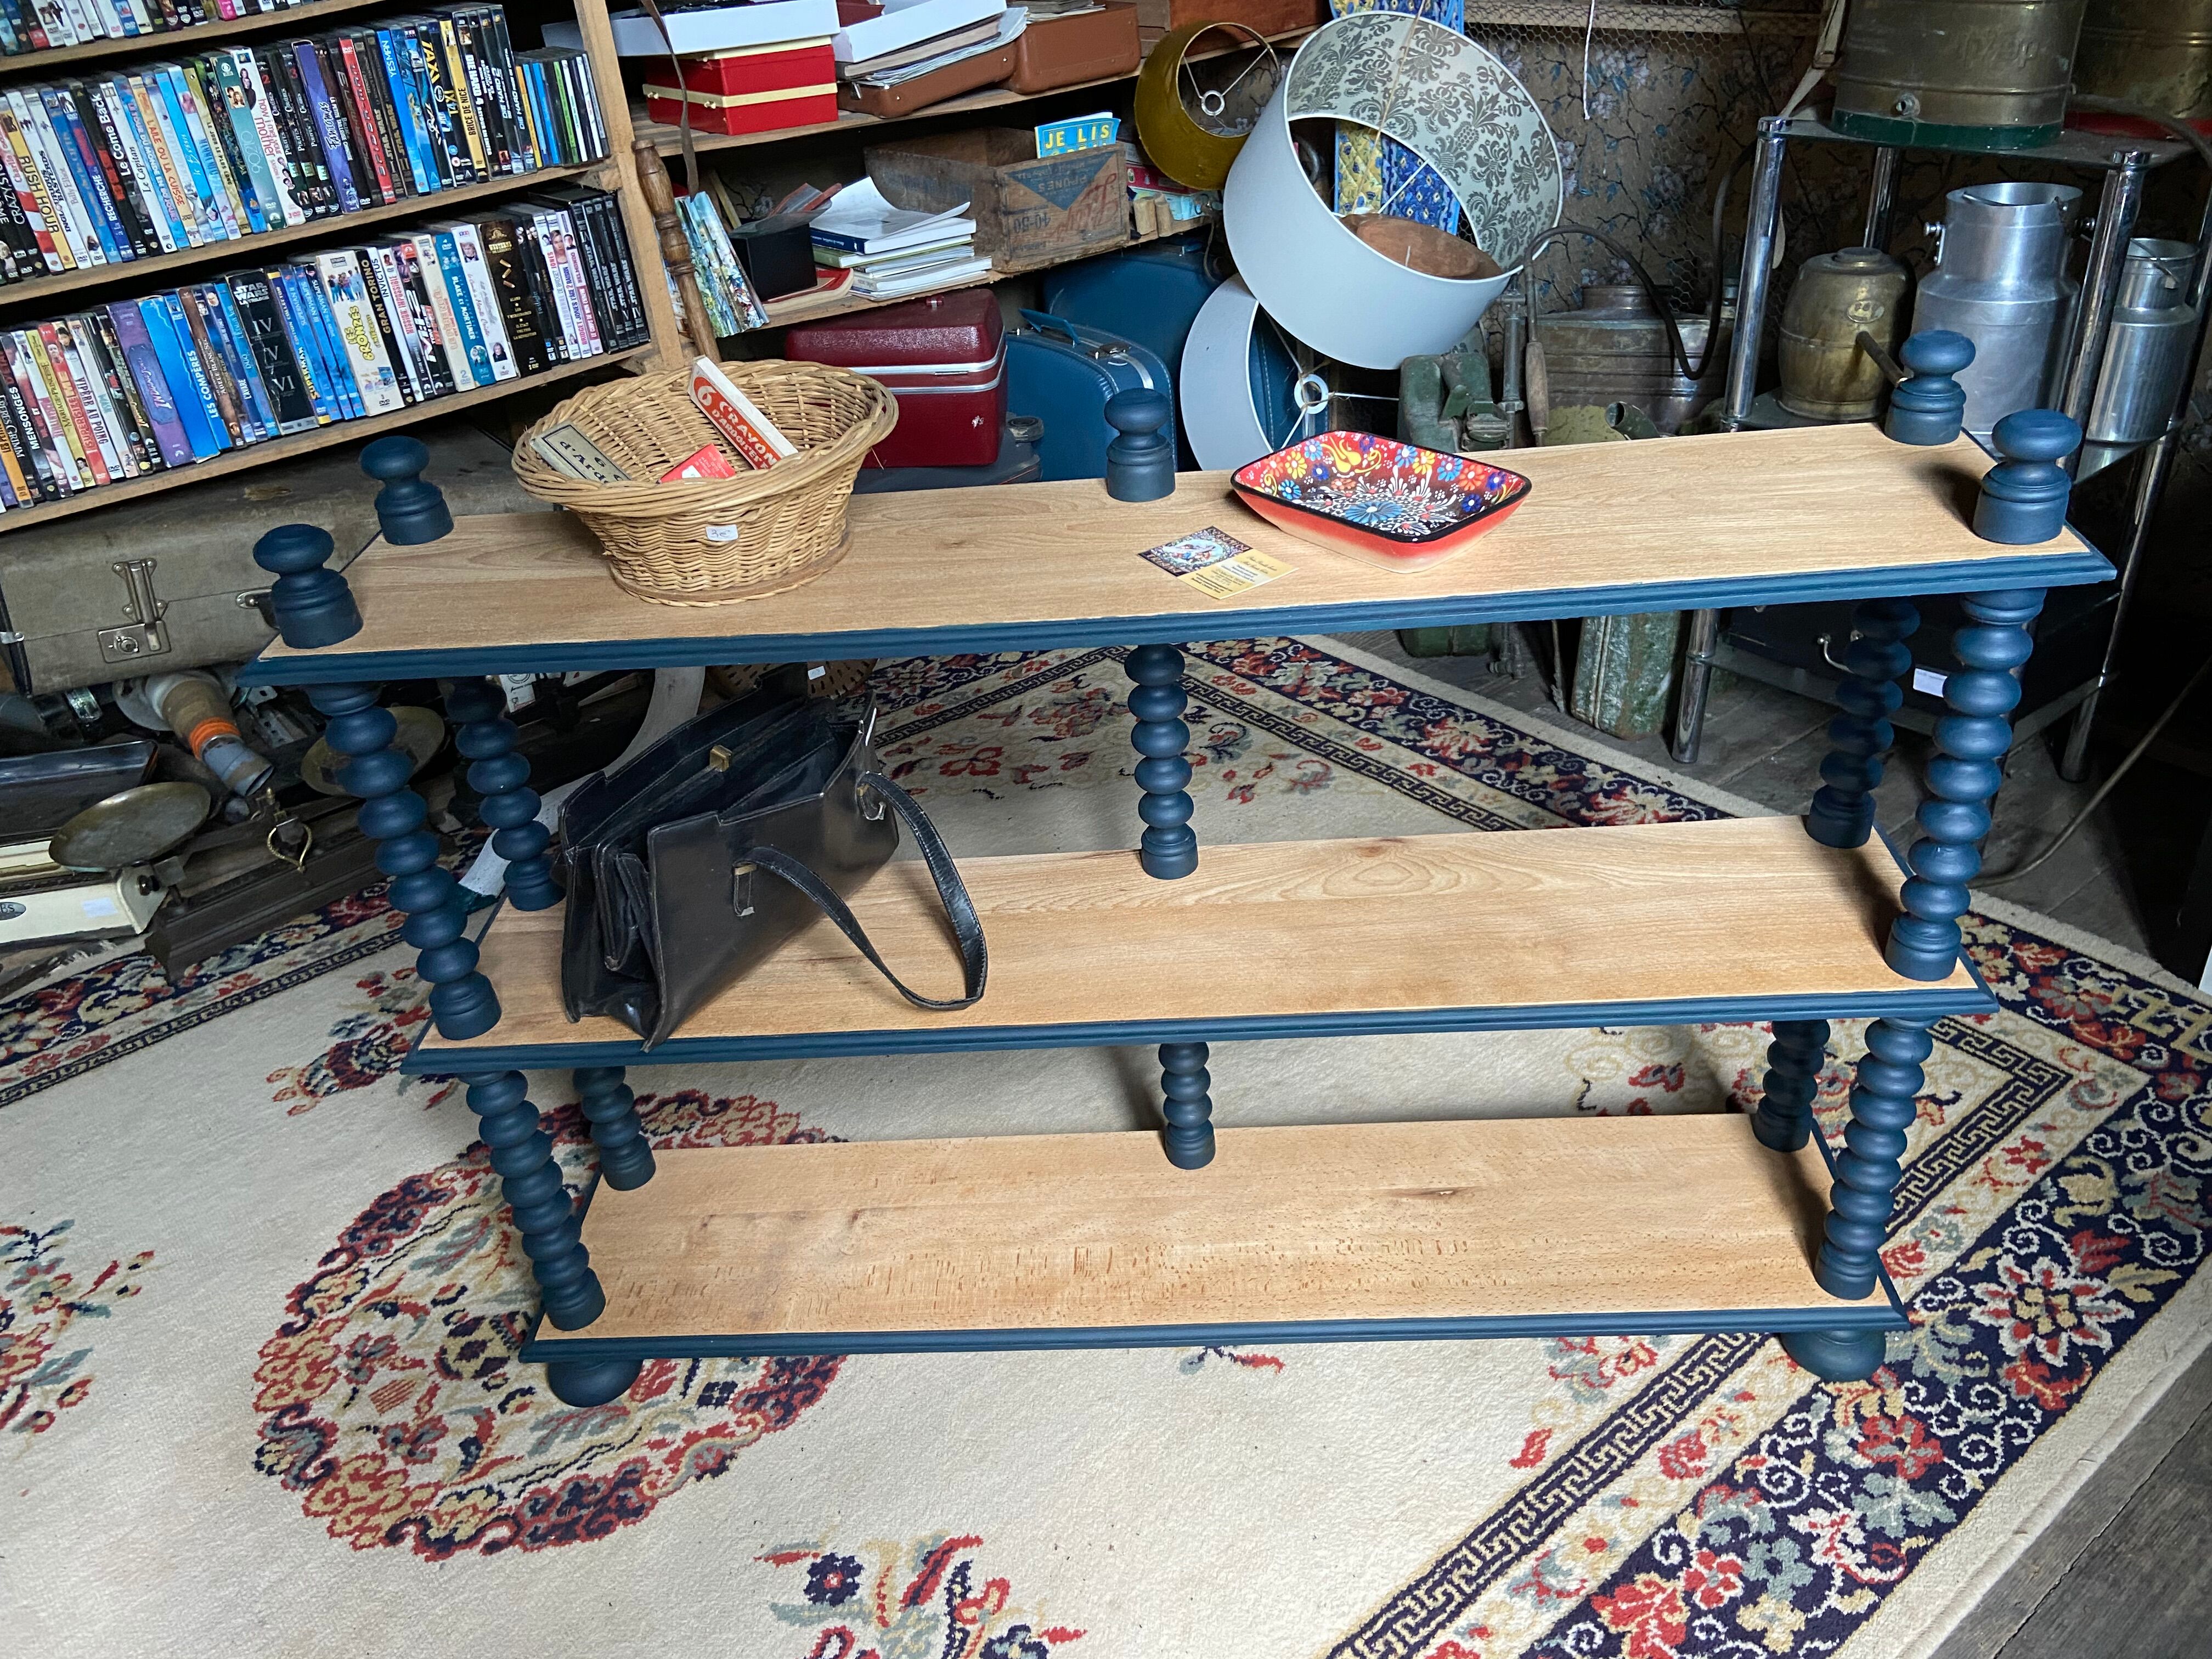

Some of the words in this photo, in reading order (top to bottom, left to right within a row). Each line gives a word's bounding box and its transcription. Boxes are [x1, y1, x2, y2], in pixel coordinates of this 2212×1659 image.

[421, 40, 441, 83] TAXI
[465, 54, 475, 70] DIE
[491, 66, 500, 77] 2
[458, 87, 467, 105] NICE
[467, 70, 482, 96] HARD
[494, 77, 505, 104] HARD
[92, 92, 111, 124] Back
[257, 99, 269, 118] how
[464, 105, 471, 116] DE
[475, 97, 484, 105] 4
[500, 104, 508, 119] DIE
[512, 90, 522, 115] HARD
[350, 64, 387, 177] SPIDER-MAN
[374, 108, 385, 135] WARS
[386, 103, 398, 131] WARS
[467, 116, 477, 137] BRICE
[517, 115, 525, 130] DIE
[105, 125, 125, 160] Come
[146, 119, 162, 145] L'AILE
[254, 117, 276, 156] mother
[267, 124, 278, 139] met
[393, 129, 405, 156] STAR
[1045, 131, 1065, 150] JE
[1077, 124, 1110, 143] LIS
[139, 135, 149, 149] DU
[144, 147, 161, 177] MONDE
[157, 147, 170, 161] OU
[208, 130, 218, 145] JOUR
[213, 146, 221, 154] LE
[217, 155, 227, 170] PLUS
[223, 170, 233, 186] LONG
[240, 131, 261, 174] 90210
[272, 138, 282, 155] your
[382, 133, 393, 160] STAR
[39, 150, 64, 201] BASTERDS
[120, 161, 131, 176] Le
[129, 146, 146, 180] Capitan
[163, 162, 174, 174] LA
[19, 156, 43, 192] RUSH
[35, 196, 59, 234] HOUR
[92, 174, 118, 222] RECHERCHE
[141, 179, 152, 193] Le
[168, 176, 185, 206] CUISSE
[42, 170, 72, 233] INGLOURIOUS
[547, 251, 557, 269] JONES
[570, 252, 583, 283] BELMONDO
[585, 244, 595, 268] STAR
[590, 268, 602, 291] WARS
[621, 259, 632, 283] WARS
[360, 258, 378, 301] TORINO
[371, 258, 390, 297] INVICTUS
[602, 264, 612, 289] WARS
[610, 262, 621, 286] WARS
[234, 282, 268, 295] STAR
[234, 289, 268, 301] WARS
[312, 279, 328, 314] SUPERMAN
[390, 275, 407, 310] IMPOSSIBLE
[608, 287, 618, 312] STAR
[617, 286, 627, 309] STAR
[628, 282, 638, 305] STAR
[376, 305, 391, 335] GRAN
[451, 275, 464, 297] BLAKE
[460, 305, 476, 340] MORTIMER
[573, 302, 582, 322] JONES
[343, 327, 358, 345] LES
[348, 305, 374, 361] BRONZÉS
[576, 321, 588, 346] BRIDGET
[57, 371, 77, 398] ME
[187, 349, 213, 402] COMPÈRES
[271, 375, 296, 392] VI
[298, 346, 321, 400] SUPERMAN
[460, 369, 467, 379] 2
[238, 379, 252, 399] L'AVARE
[697, 385, 717, 407] 6
[9, 386, 41, 450] MENSONGES
[57, 398, 72, 427] MARIAGE
[66, 397, 83, 419] SIZE
[75, 376, 94, 406] VIPÈRE
[87, 408, 97, 423] AU
[93, 424, 109, 445] POING
[206, 404, 219, 419] LES
[6, 424, 25, 459] GRIMM
[75, 416, 95, 452] SUPER
[712, 409, 761, 463] D'ARDOISES
[595, 456, 606, 468] 6
